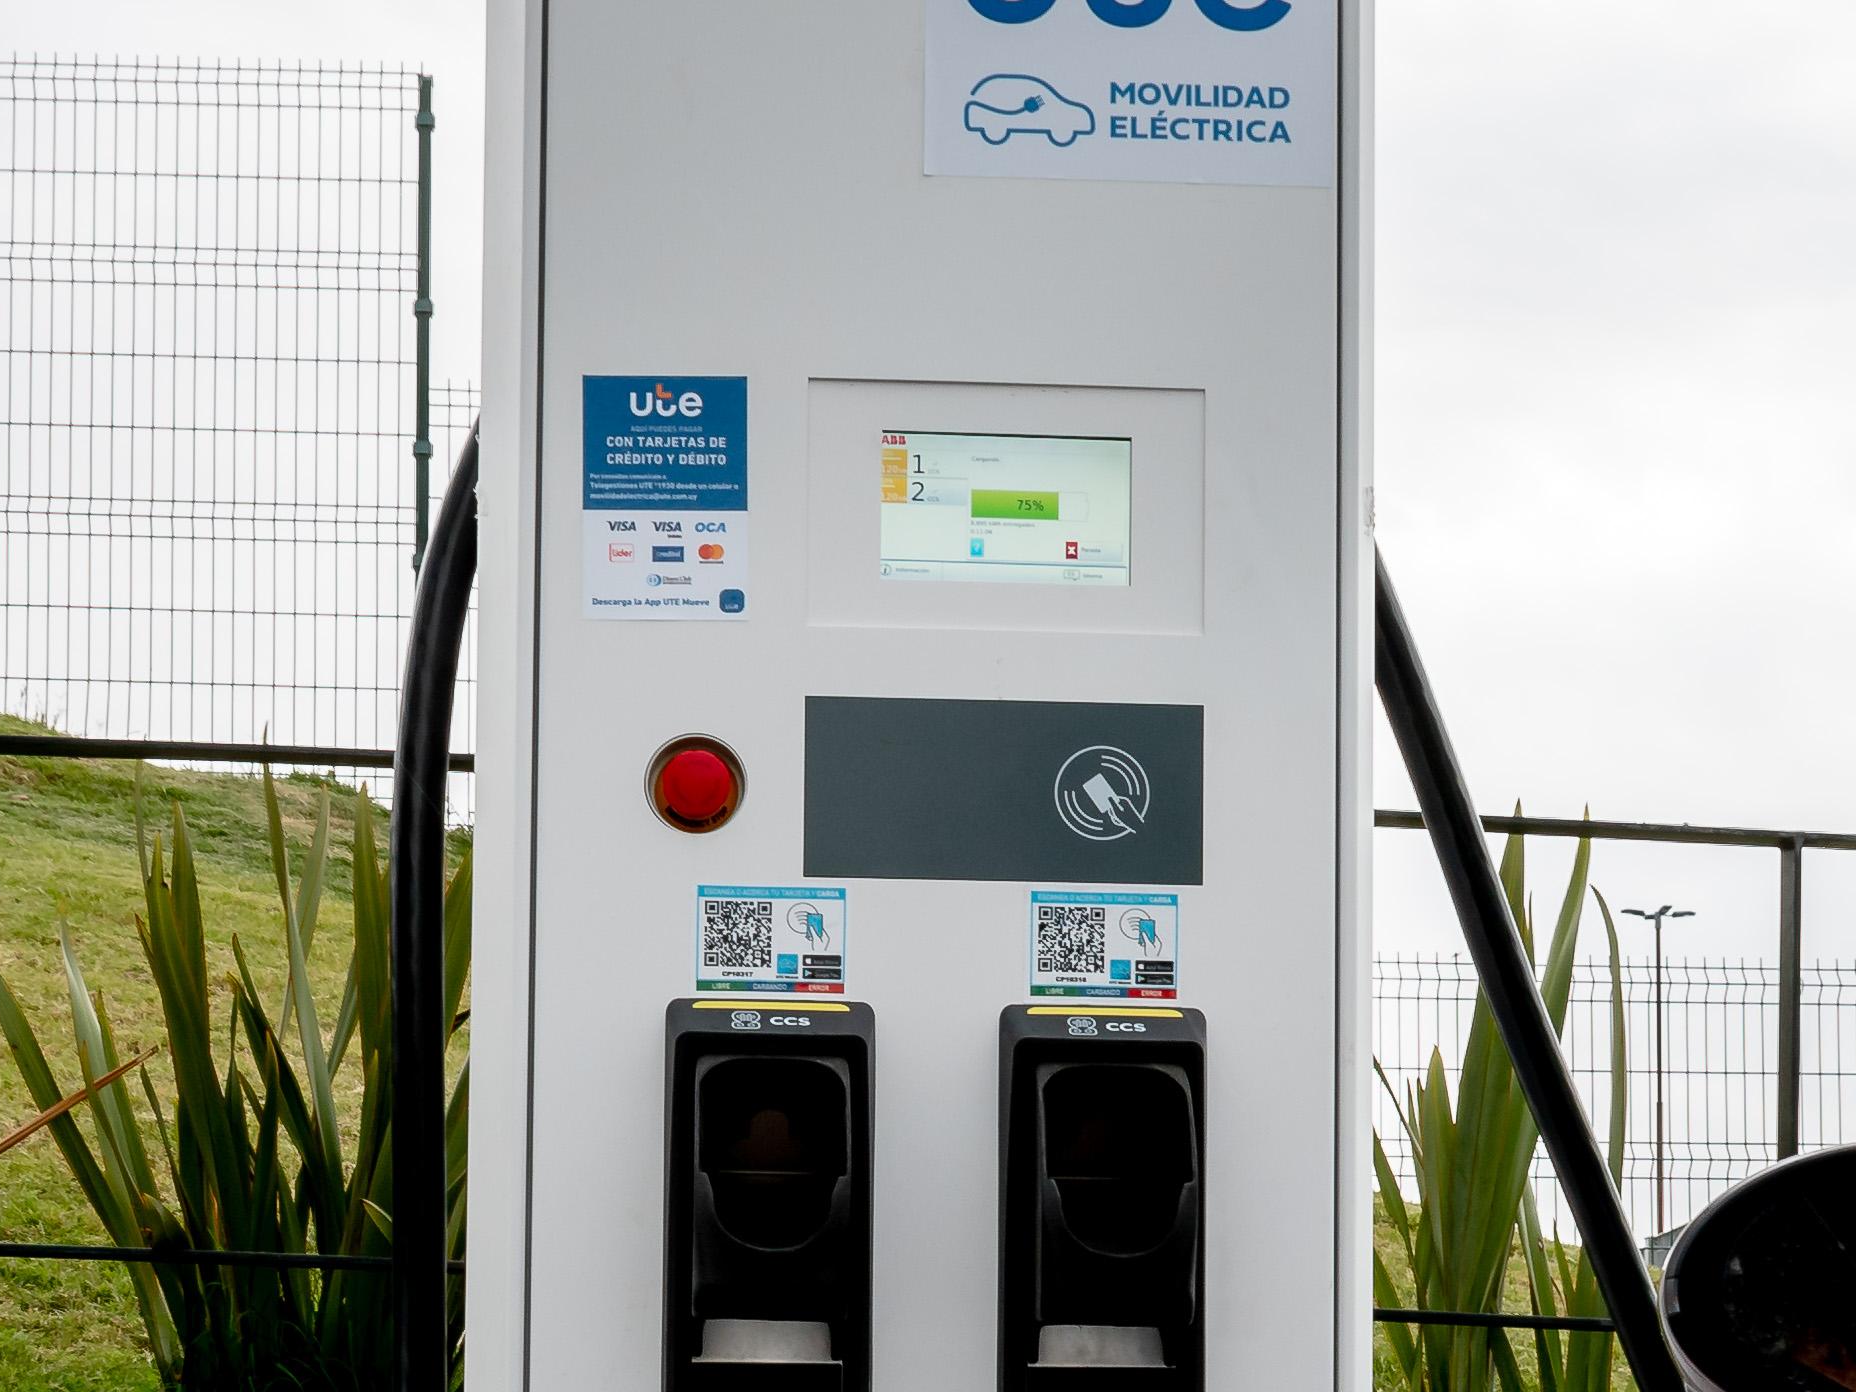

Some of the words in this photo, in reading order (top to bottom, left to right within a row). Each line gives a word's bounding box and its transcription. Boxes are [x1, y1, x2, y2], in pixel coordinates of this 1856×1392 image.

[1109, 81, 1291, 110] MOVILIDAD
[1109, 110, 1292, 144] ELÉCTRICA
[629, 383, 703, 417] ute
[606, 436, 633, 448] CON
[637, 436, 705, 448] TARJETAS
[709, 436, 727, 448] DE
[881, 435, 906, 445] ABB
[606, 451, 663, 465] CRÉDITO
[667, 454, 675, 465] Y
[678, 451, 727, 466] DÉBITO
[913, 454, 925, 474] 1
[911, 482, 925, 502] 2
[1017, 499, 1045, 512] 75%
[607, 521, 637, 532] VISA
[651, 521, 682, 532] VISA
[695, 522, 727, 533] OCA
[592, 598, 632, 608] Descarga
[634, 598, 642, 606] la
[644, 598, 661, 608] App
[663, 598, 680, 606] UTE
[711, 982, 731, 990] LIBRE
[808, 984, 830, 992] ERROR
[769, 1016, 811, 1026] CCS
[1105, 1022, 1147, 1033] CCS
